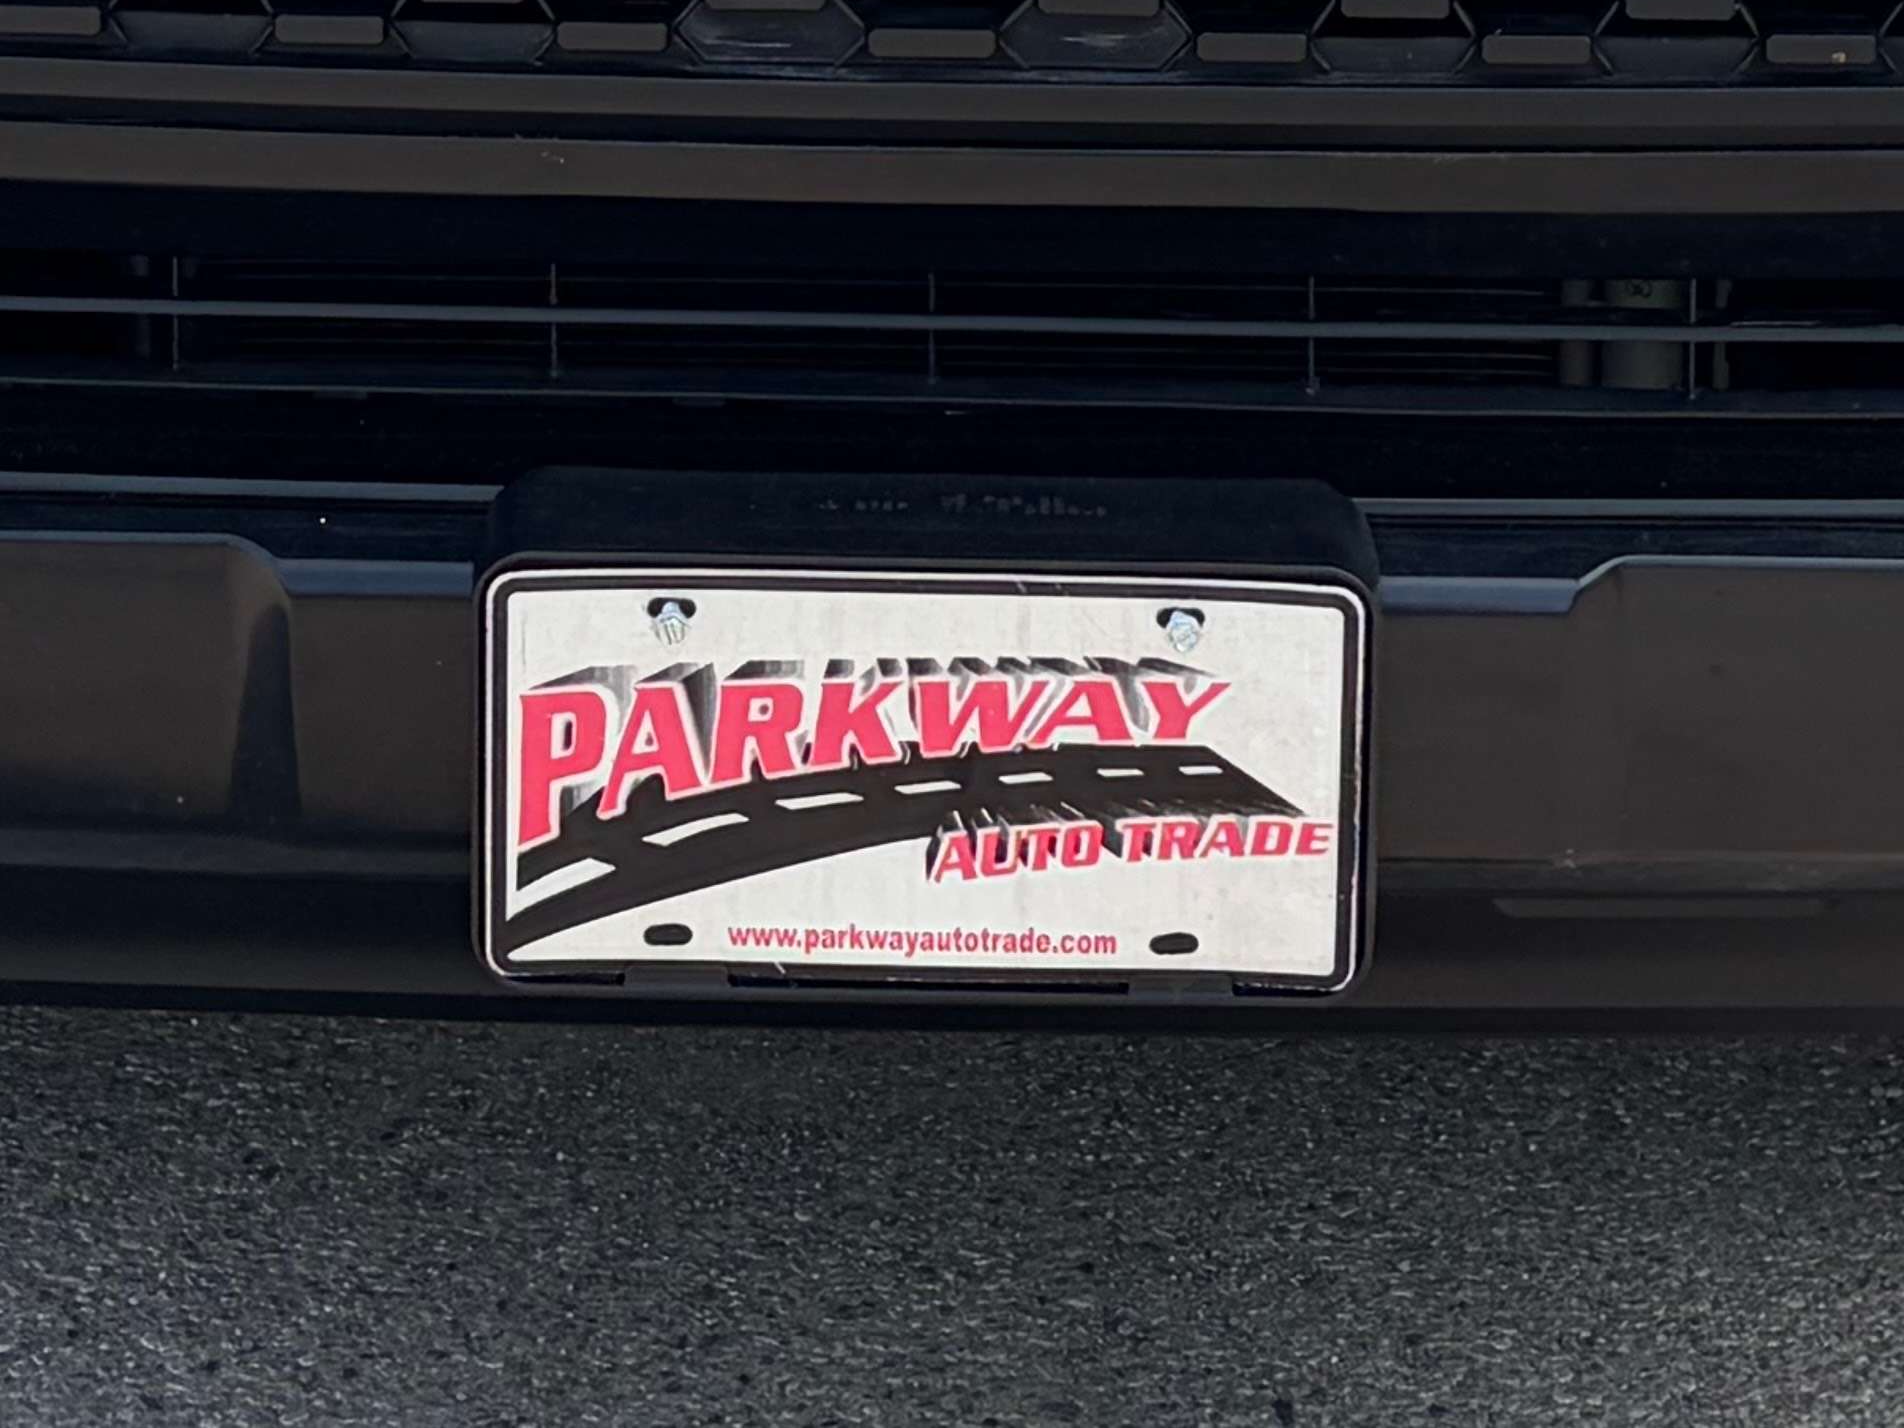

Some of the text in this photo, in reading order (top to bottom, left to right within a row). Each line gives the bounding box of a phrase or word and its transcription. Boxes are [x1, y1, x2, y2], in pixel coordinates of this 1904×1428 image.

[516, 678, 1231, 847] PARKWAY
[933, 819, 1332, 882] AUTO TRADE
[728, 924, 1118, 958] www.parkwayautotrade.com
